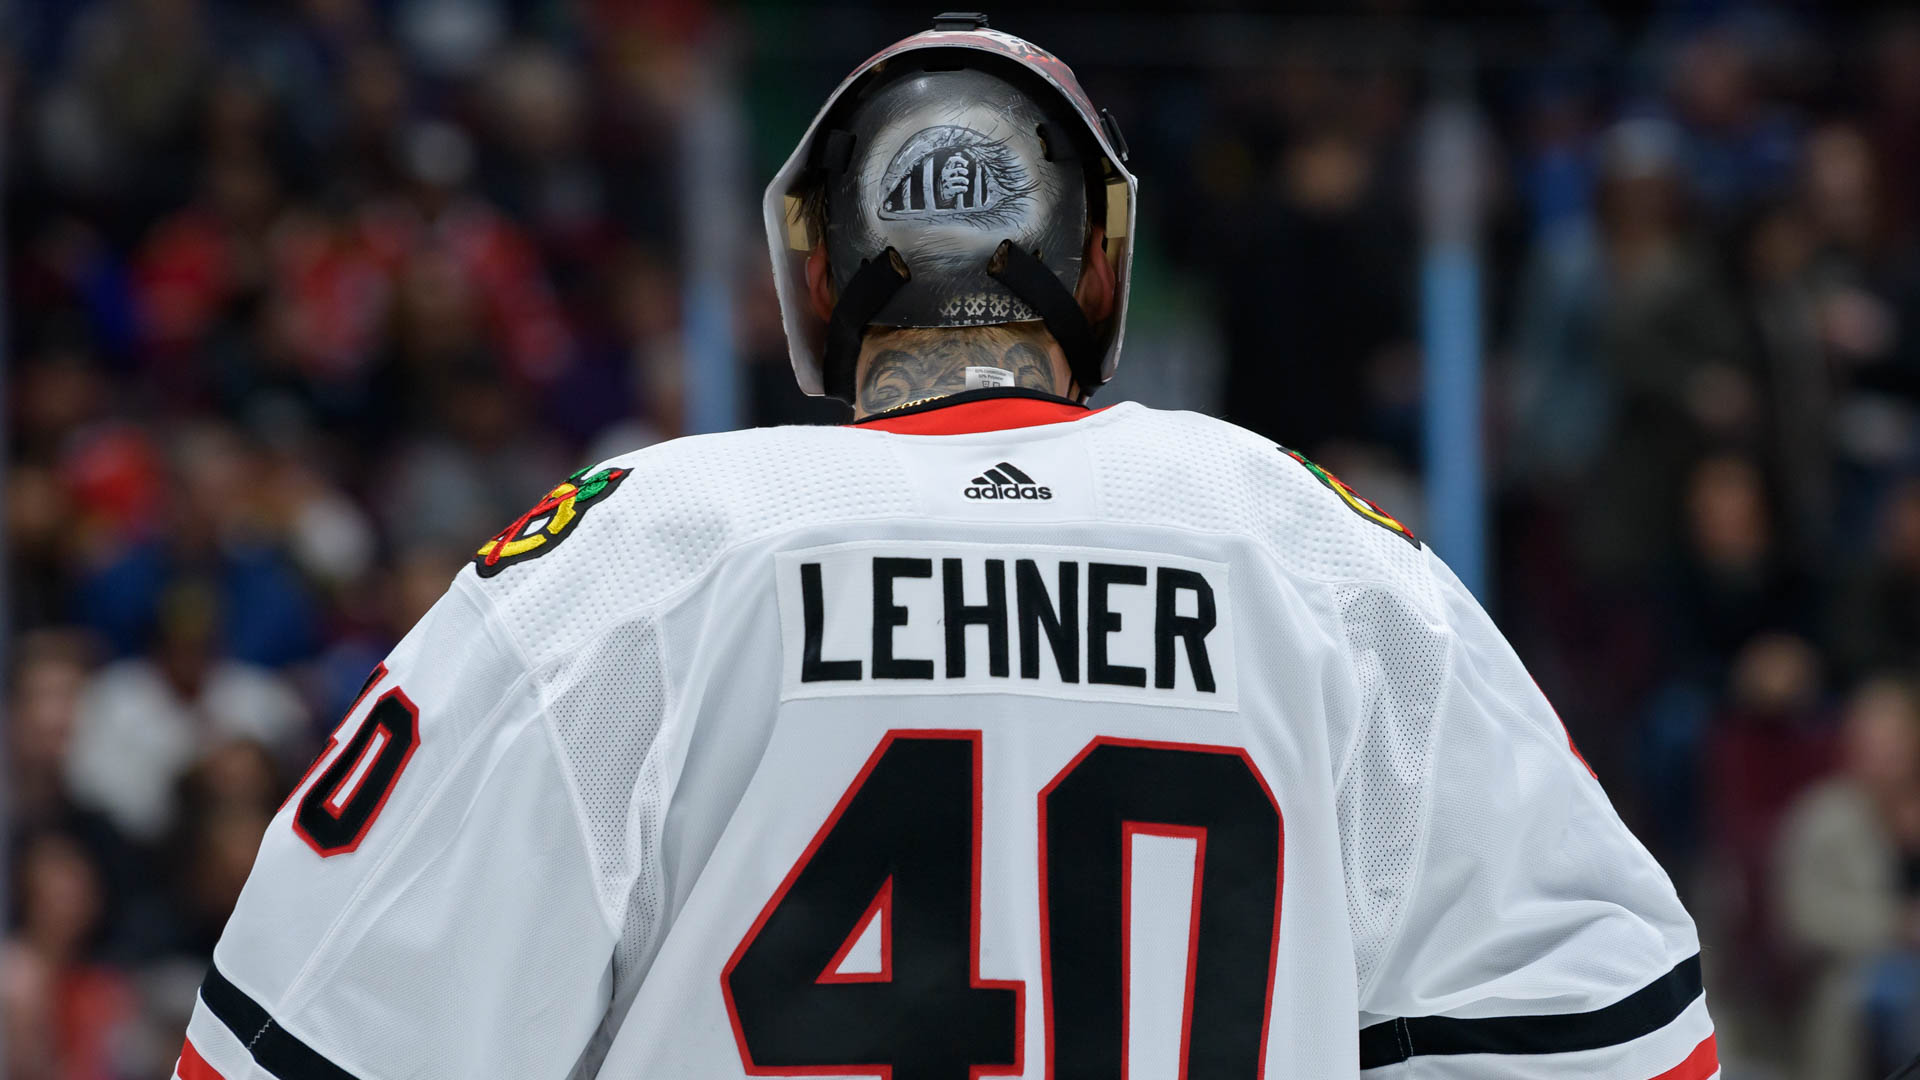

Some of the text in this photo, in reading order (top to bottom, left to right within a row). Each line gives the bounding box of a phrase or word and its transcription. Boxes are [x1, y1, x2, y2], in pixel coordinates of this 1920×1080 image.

[964, 483, 1053, 500] adidas
[801, 556, 1217, 694] LEHNER
[720, 729, 1284, 1080] 40
